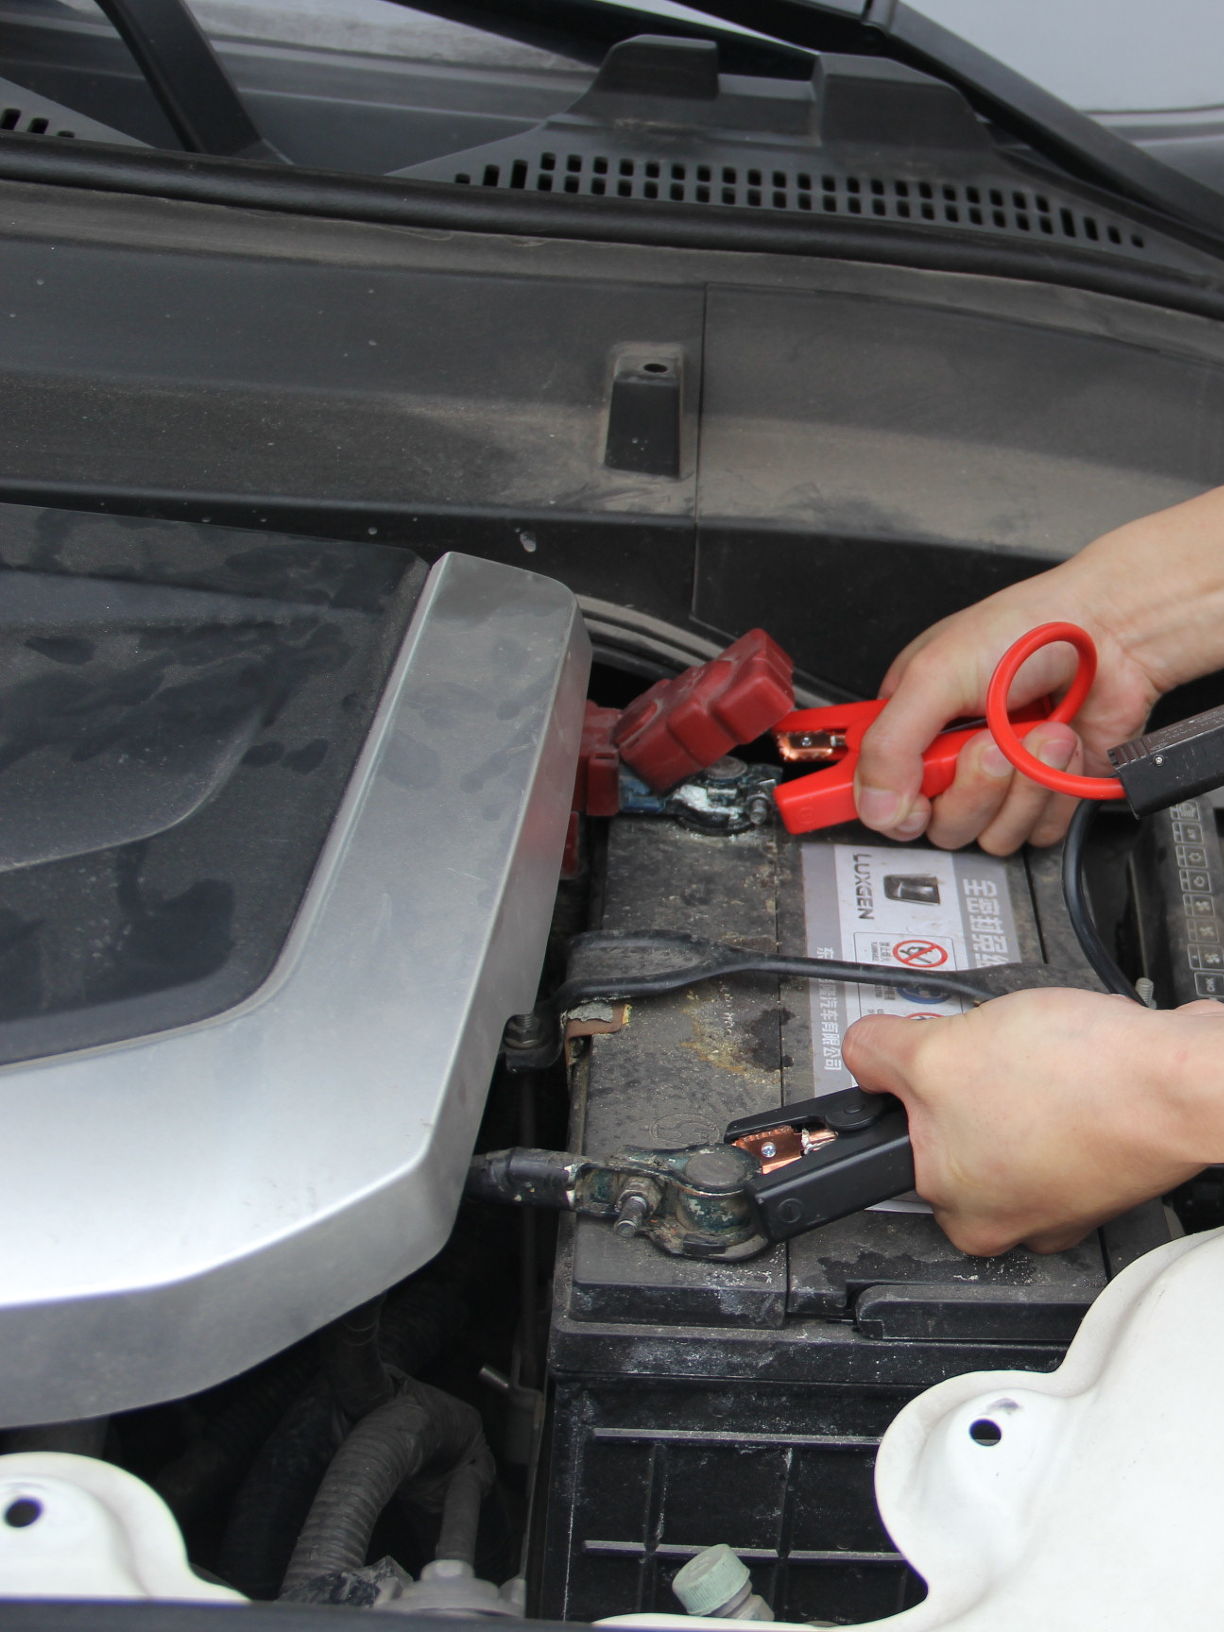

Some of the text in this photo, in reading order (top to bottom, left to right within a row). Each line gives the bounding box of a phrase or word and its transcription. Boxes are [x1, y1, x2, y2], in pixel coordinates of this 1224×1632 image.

[853, 853, 874, 920] LUXGEN
[816, 946, 842, 1071] 东隆汽车有限公司
